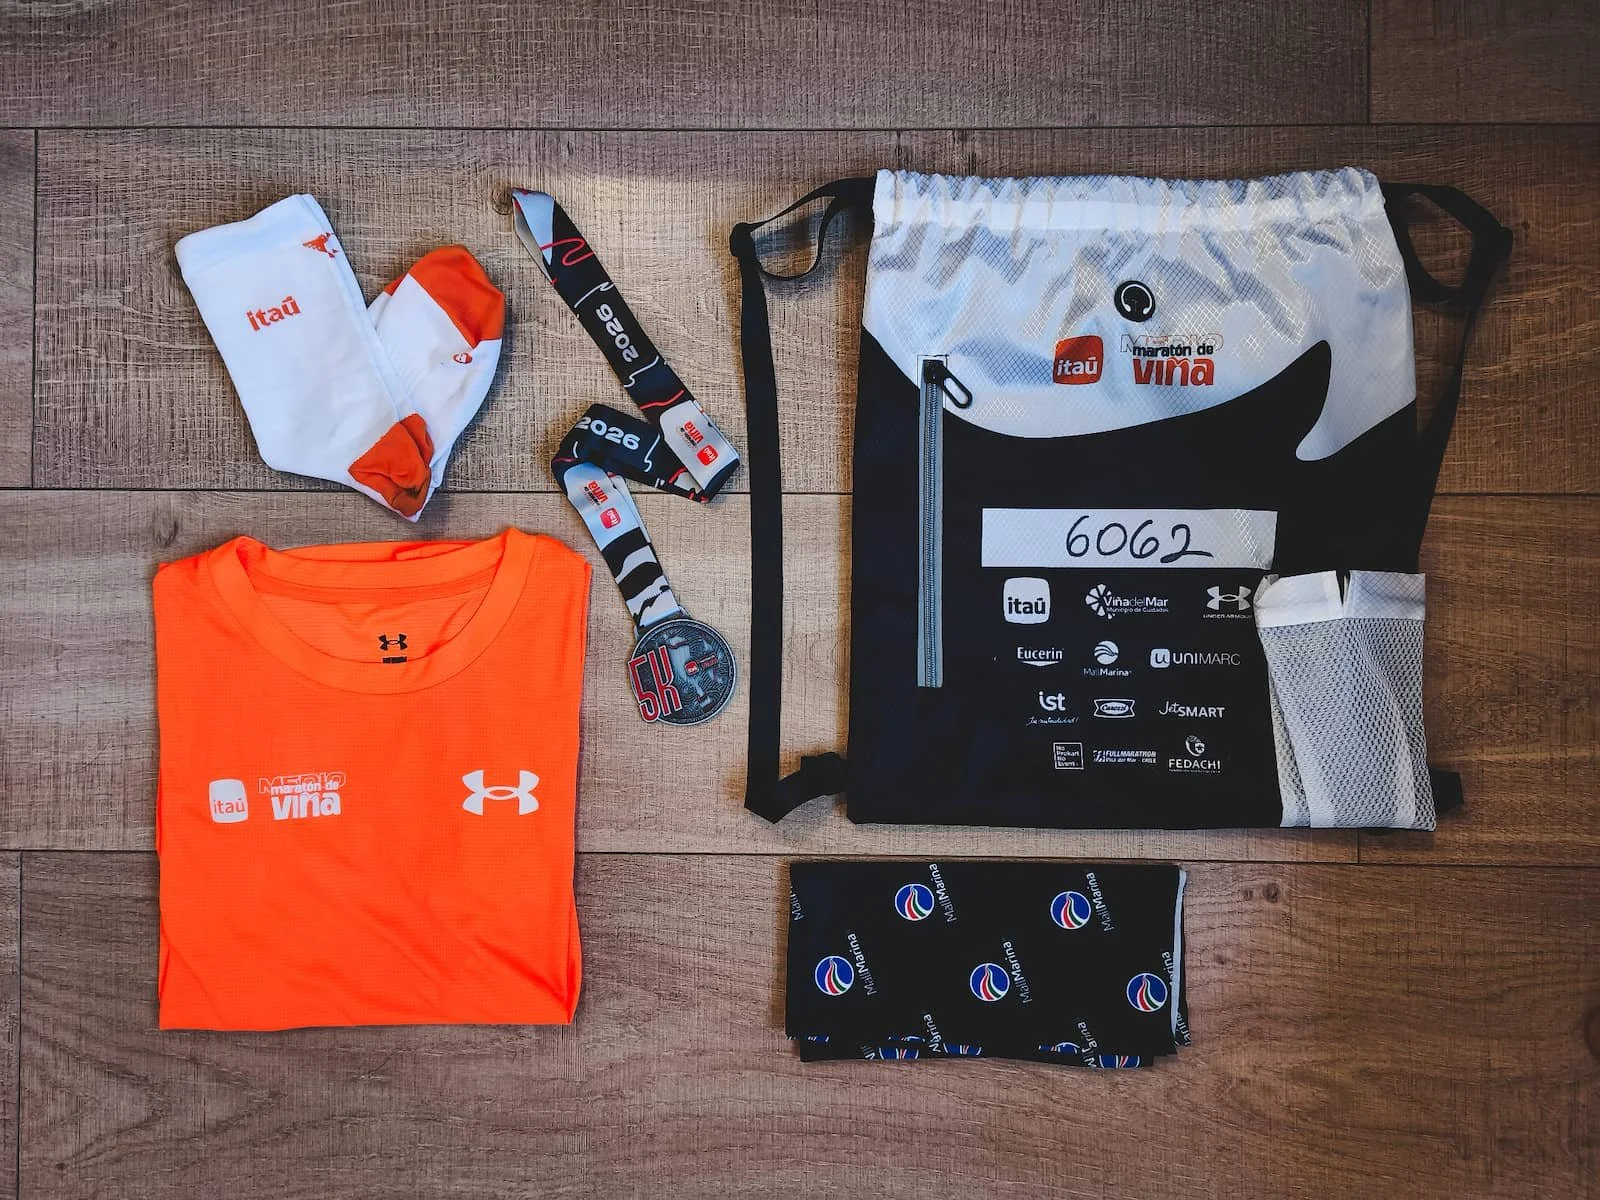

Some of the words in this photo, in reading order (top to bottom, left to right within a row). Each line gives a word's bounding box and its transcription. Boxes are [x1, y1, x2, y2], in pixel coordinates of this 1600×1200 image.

[246, 296, 301, 332] itaú
[596, 303, 640, 363] 2026
[1132, 344, 1192, 358] maratón
[1196, 343, 1214, 356] de
[1056, 356, 1098, 376] itaú
[580, 416, 641, 451] 2026
[1066, 515, 1215, 564] 6062
[1007, 597, 1046, 615] itaú
[1017, 647, 1063, 661] Eucerin
[628, 645, 683, 723] 5K
[1038, 691, 1066, 711] ist
[1168, 758, 1221, 770] FEDACHI
[270, 781, 322, 795] maratón
[325, 779, 340, 791] de
[213, 797, 245, 815] itaú
[929, 863, 958, 923] MallMarina
[1086, 872, 1115, 932] MallMarina
[847, 933, 877, 996] MallMarina
[1003, 941, 1033, 1004] MallMarina
